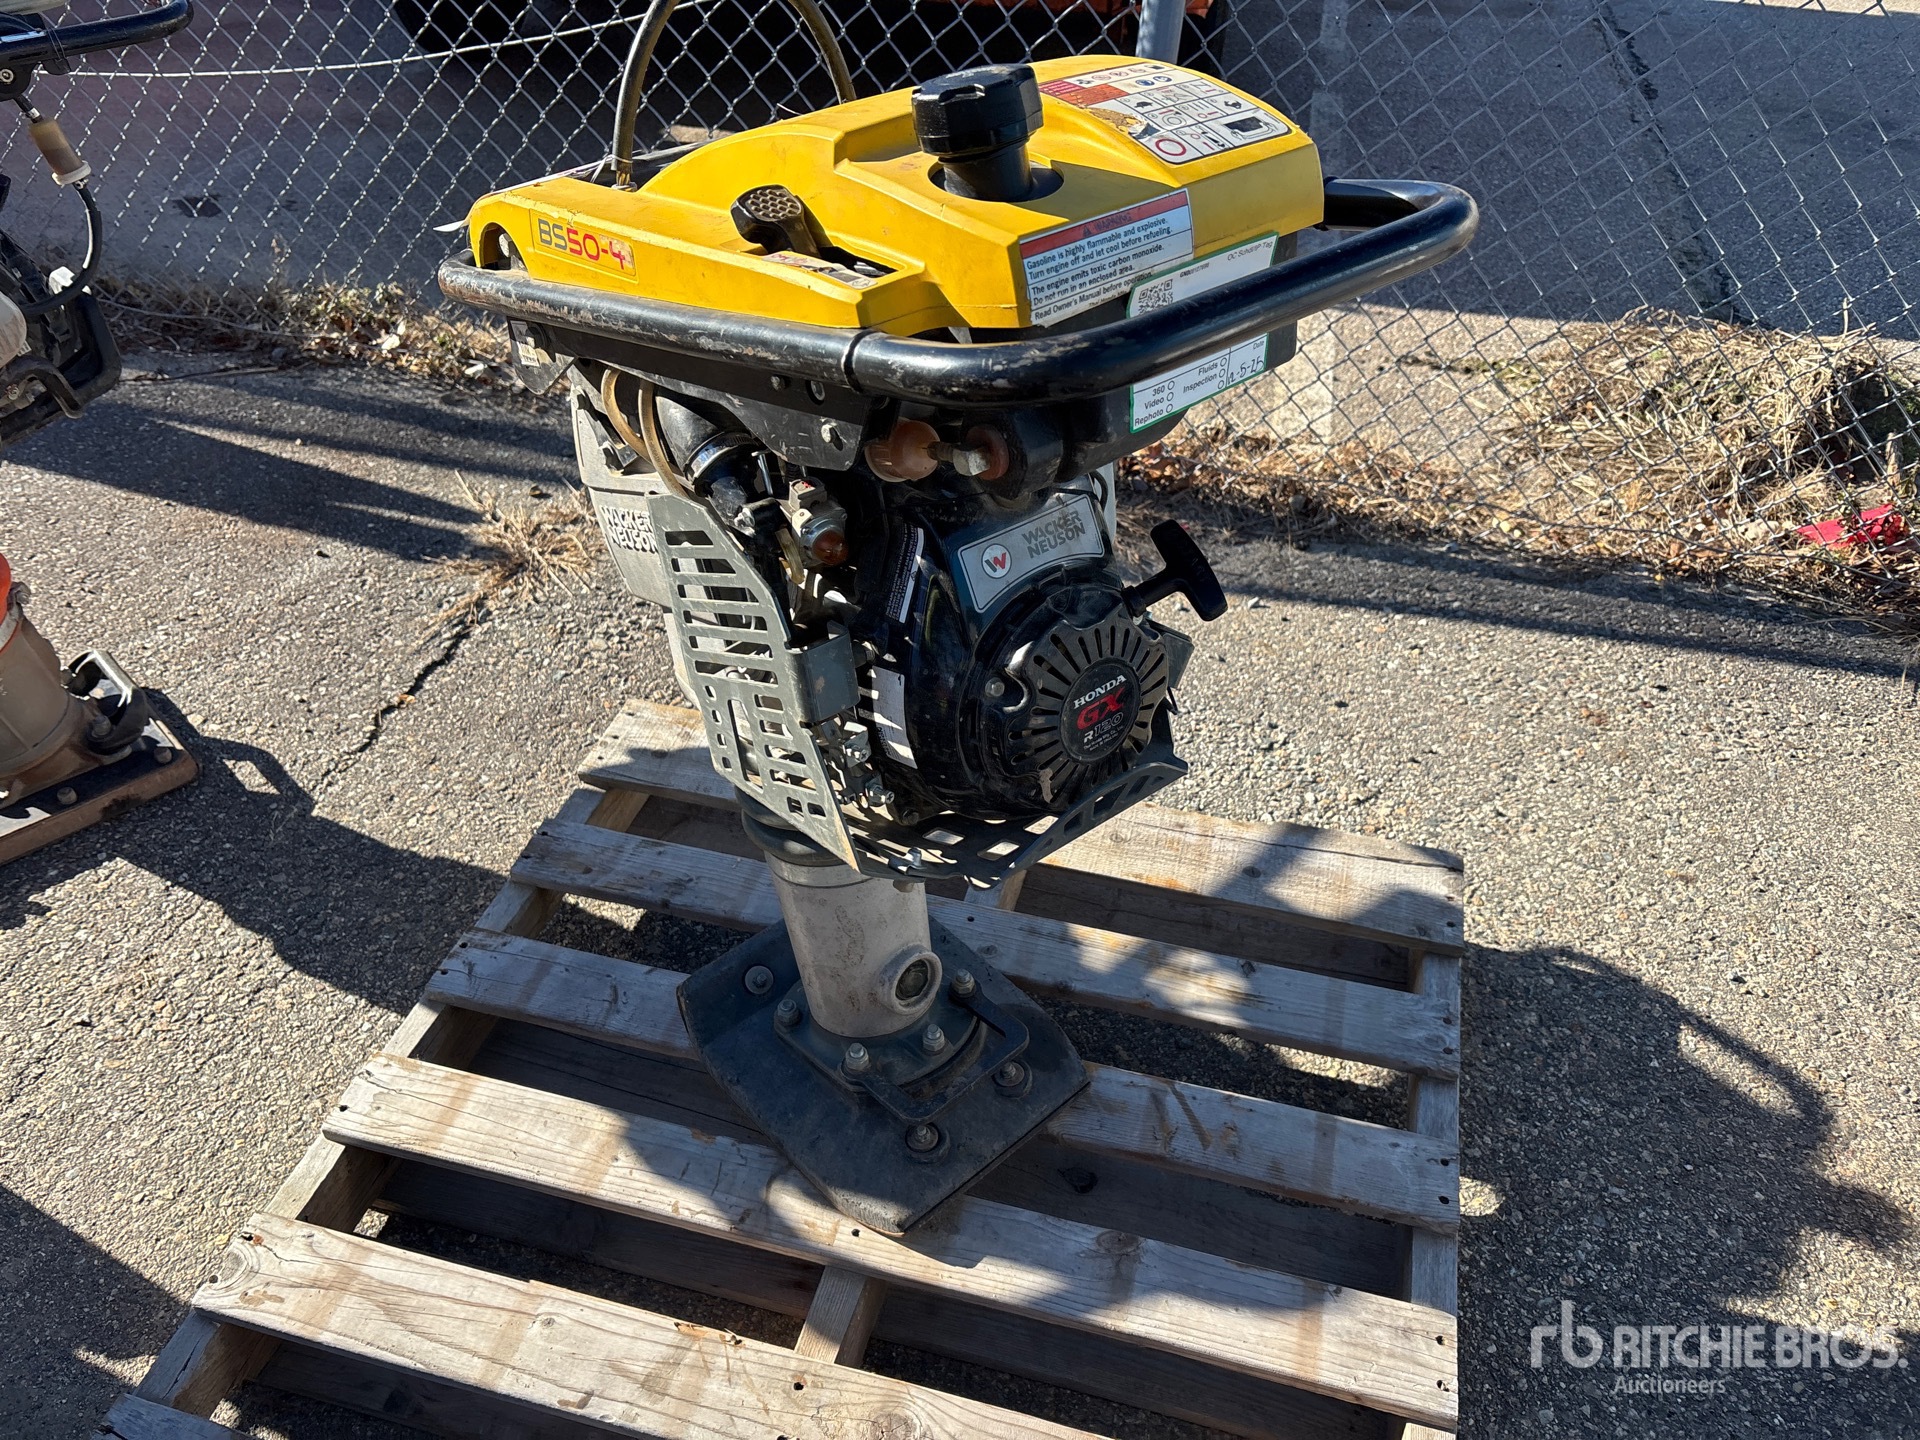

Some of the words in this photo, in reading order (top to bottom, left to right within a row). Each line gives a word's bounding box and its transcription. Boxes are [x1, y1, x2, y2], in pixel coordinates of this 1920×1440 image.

[538, 218, 625, 270] BS50-4
[1027, 254, 1056, 270] Gasoline
[1057, 252, 1064, 260] is
[1065, 244, 1086, 258] highly
[1087, 232, 1122, 248] flammable
[1123, 227, 1135, 237] and
[1137, 217, 1168, 233] explosive.
[1029, 267, 1045, 280] Turn
[1046, 261, 1070, 276] engine
[1070, 256, 1080, 266] off
[1081, 252, 1094, 262] and
[1095, 248, 1104, 258] let
[1105, 243, 1120, 255] cool
[1120, 234, 1142, 250] before
[1143, 226, 1172, 243] refueling.
[1031, 283, 1045, 296] The
[1046, 276, 1070, 291] engine
[1071, 270, 1089, 282] emits
[1090, 264, 1106, 277] toxic
[1107, 255, 1131, 271] carbon
[1131, 244, 1164, 261] monoxide.
[1033, 296, 1044, 306] Do
[1044, 291, 1056, 303] not
[1057, 288, 1069, 299] run
[1070, 284, 1078, 294] in
[1078, 281, 1087, 291] an
[1088, 270, 1118, 287] enclosed
[1118, 265, 1136, 278] area.
[1034, 306, 1051, 321] Read
[1052, 296, 1079, 313] Owner's
[1079, 286, 1102, 304] Manual
[1102, 279, 1123, 295] before
[1252, 340, 1265, 350] Date
[1183, 373, 1218, 393] Inspection
[1198, 362, 1218, 376] Fluids
[1144, 396, 1165, 410] Video
[1152, 385, 1165, 397] 360
[1134, 410, 1164, 426] Rephoto
[600, 505, 653, 533] WACKER
[1021, 510, 1082, 545] WACKER
[608, 526, 659, 554] NEUSON
[1027, 523, 1086, 558] NEUSON
[1073, 675, 1127, 709] HONDA
[1077, 687, 1126, 730] GX
